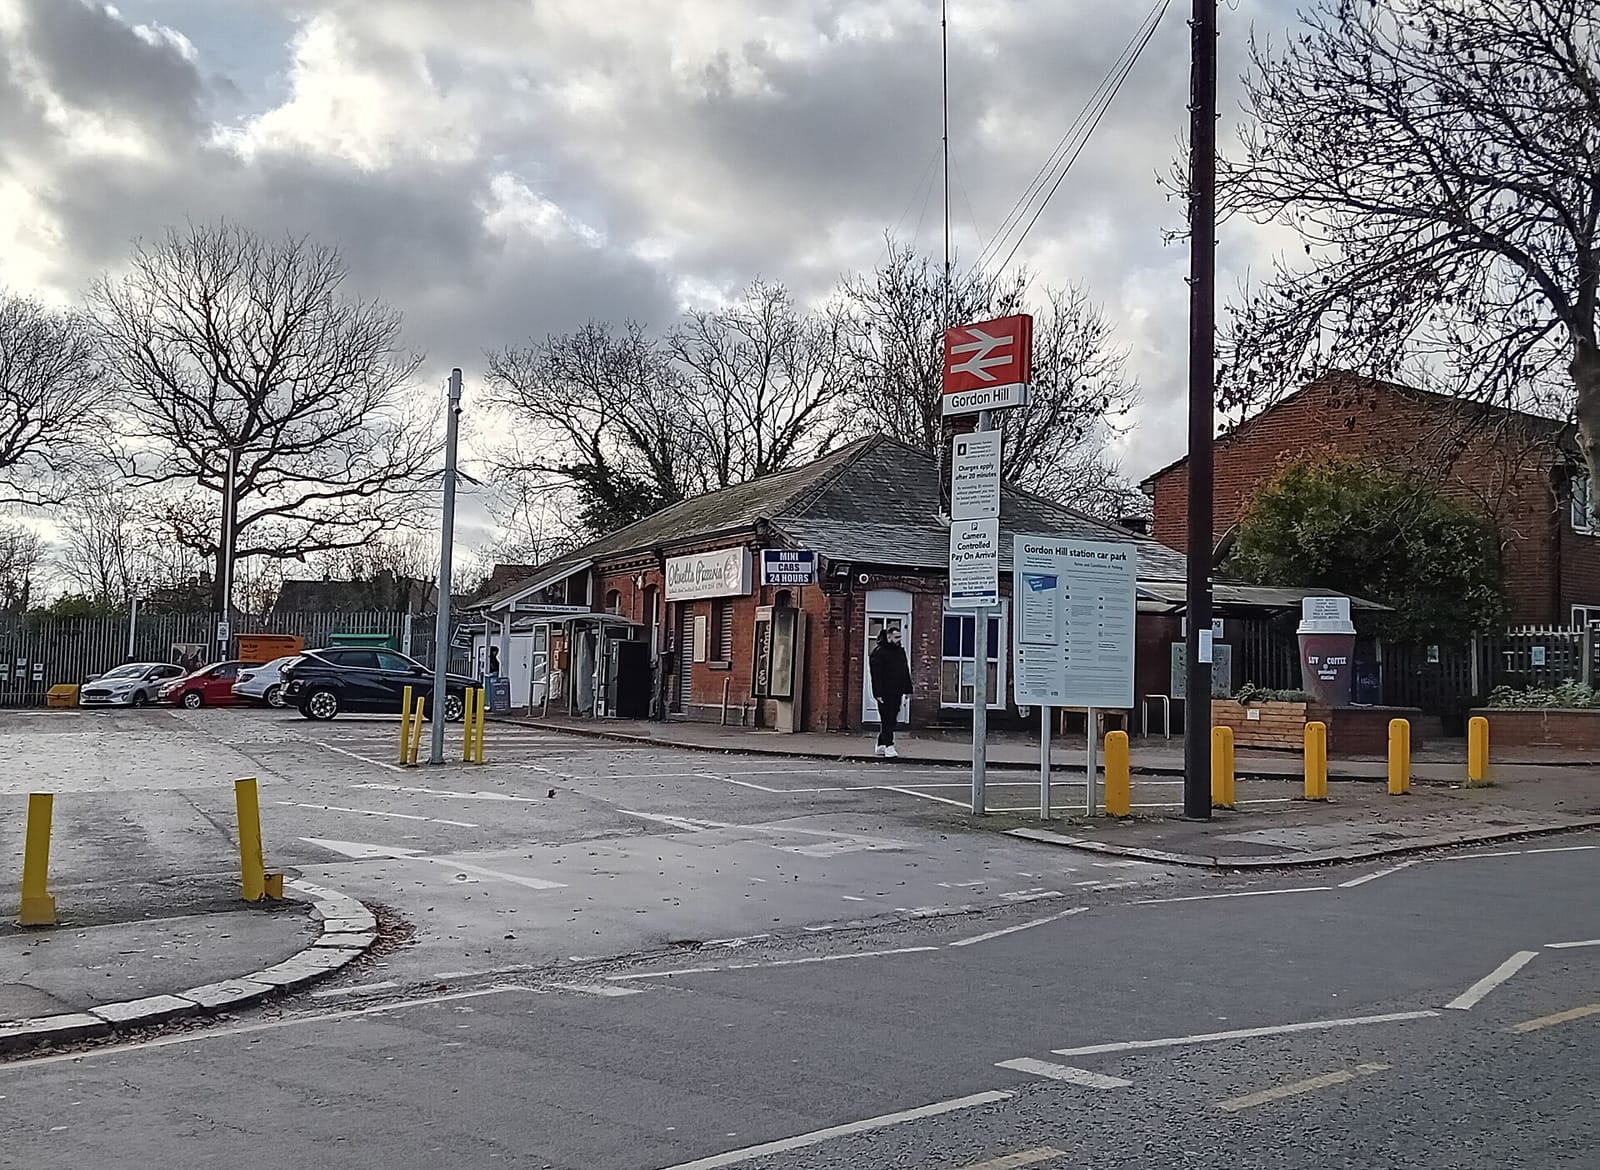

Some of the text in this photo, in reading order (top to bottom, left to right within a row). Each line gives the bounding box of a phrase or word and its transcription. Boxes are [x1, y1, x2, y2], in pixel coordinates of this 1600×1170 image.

[952, 388, 1008, 408] Gordon Hill
[958, 462, 994, 472] Charges apply
[957, 541, 990, 550] Controlled
[780, 552, 798, 561] MINI
[952, 554, 963, 562] Pay
[975, 551, 996, 559] Arrival
[1024, 544, 1053, 555] Gordon
[1055, 546, 1068, 556] Hill
[1070, 548, 1095, 558] station
[1110, 552, 1127, 562] park
[778, 563, 800, 572] CABS
[770, 574, 809, 582] 24 HOURS
